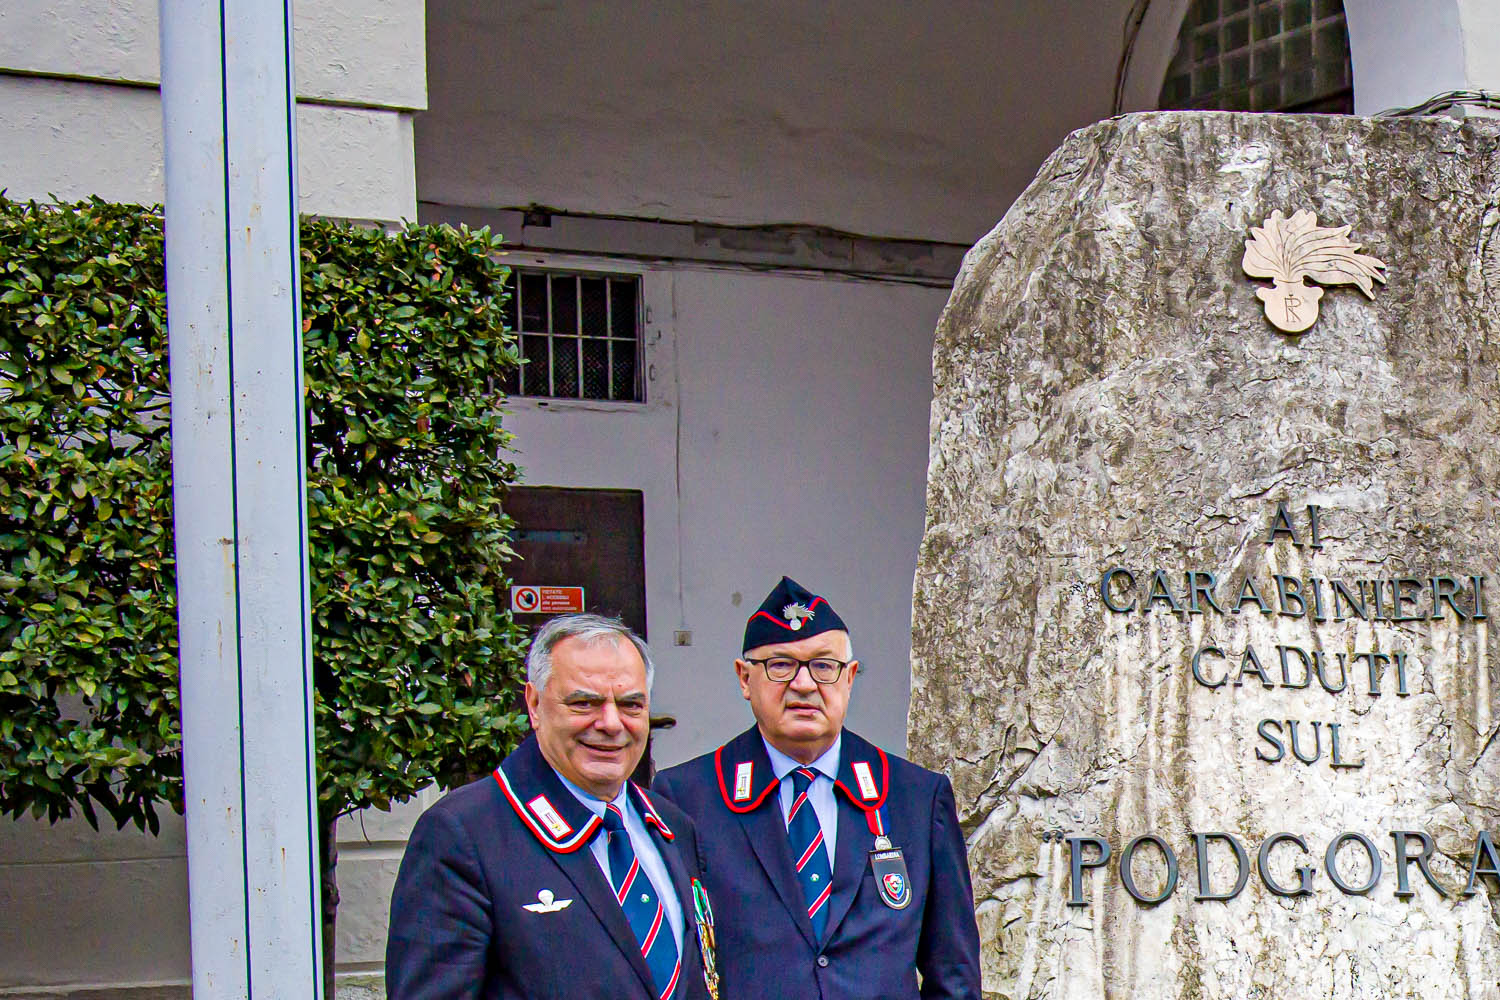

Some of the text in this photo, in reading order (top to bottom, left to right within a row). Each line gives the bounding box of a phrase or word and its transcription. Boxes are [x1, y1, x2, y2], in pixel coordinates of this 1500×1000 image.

[1265, 500, 1324, 549] AI
[1100, 567, 1488, 622] CARABINIERI
[1191, 643, 1411, 697] CADUTI
[1255, 718, 1366, 769] SUL
